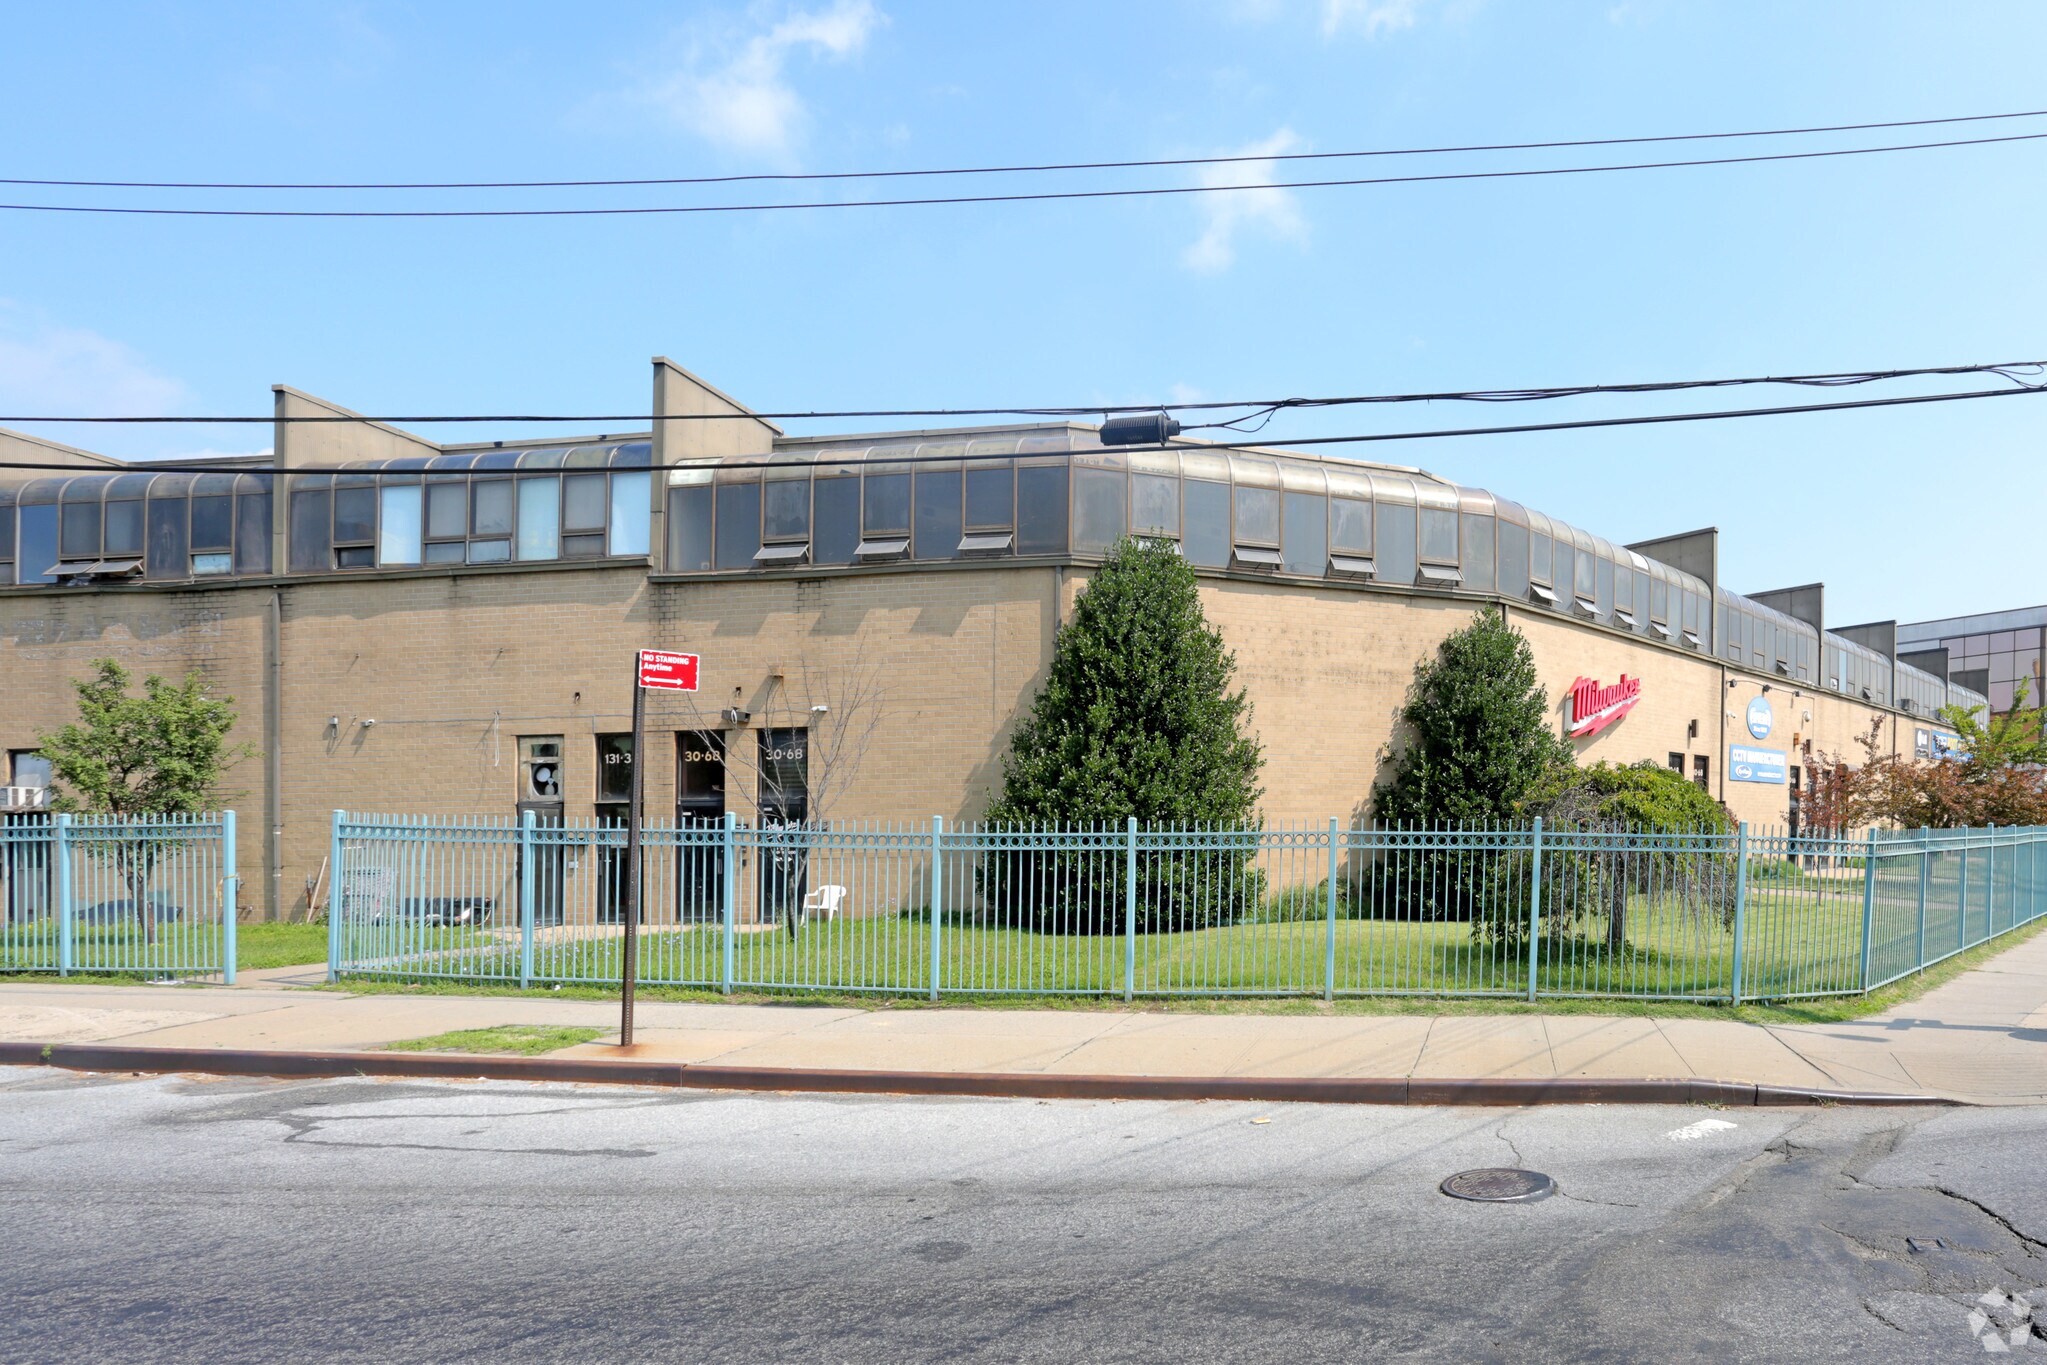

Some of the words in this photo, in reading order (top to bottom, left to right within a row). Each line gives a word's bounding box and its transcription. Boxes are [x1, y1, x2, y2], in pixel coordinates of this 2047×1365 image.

[643, 654, 654, 662] NO
[655, 655, 690, 665] STANDING
[644, 662, 673, 671] Anytime
[1567, 673, 1642, 723] Milwaukee
